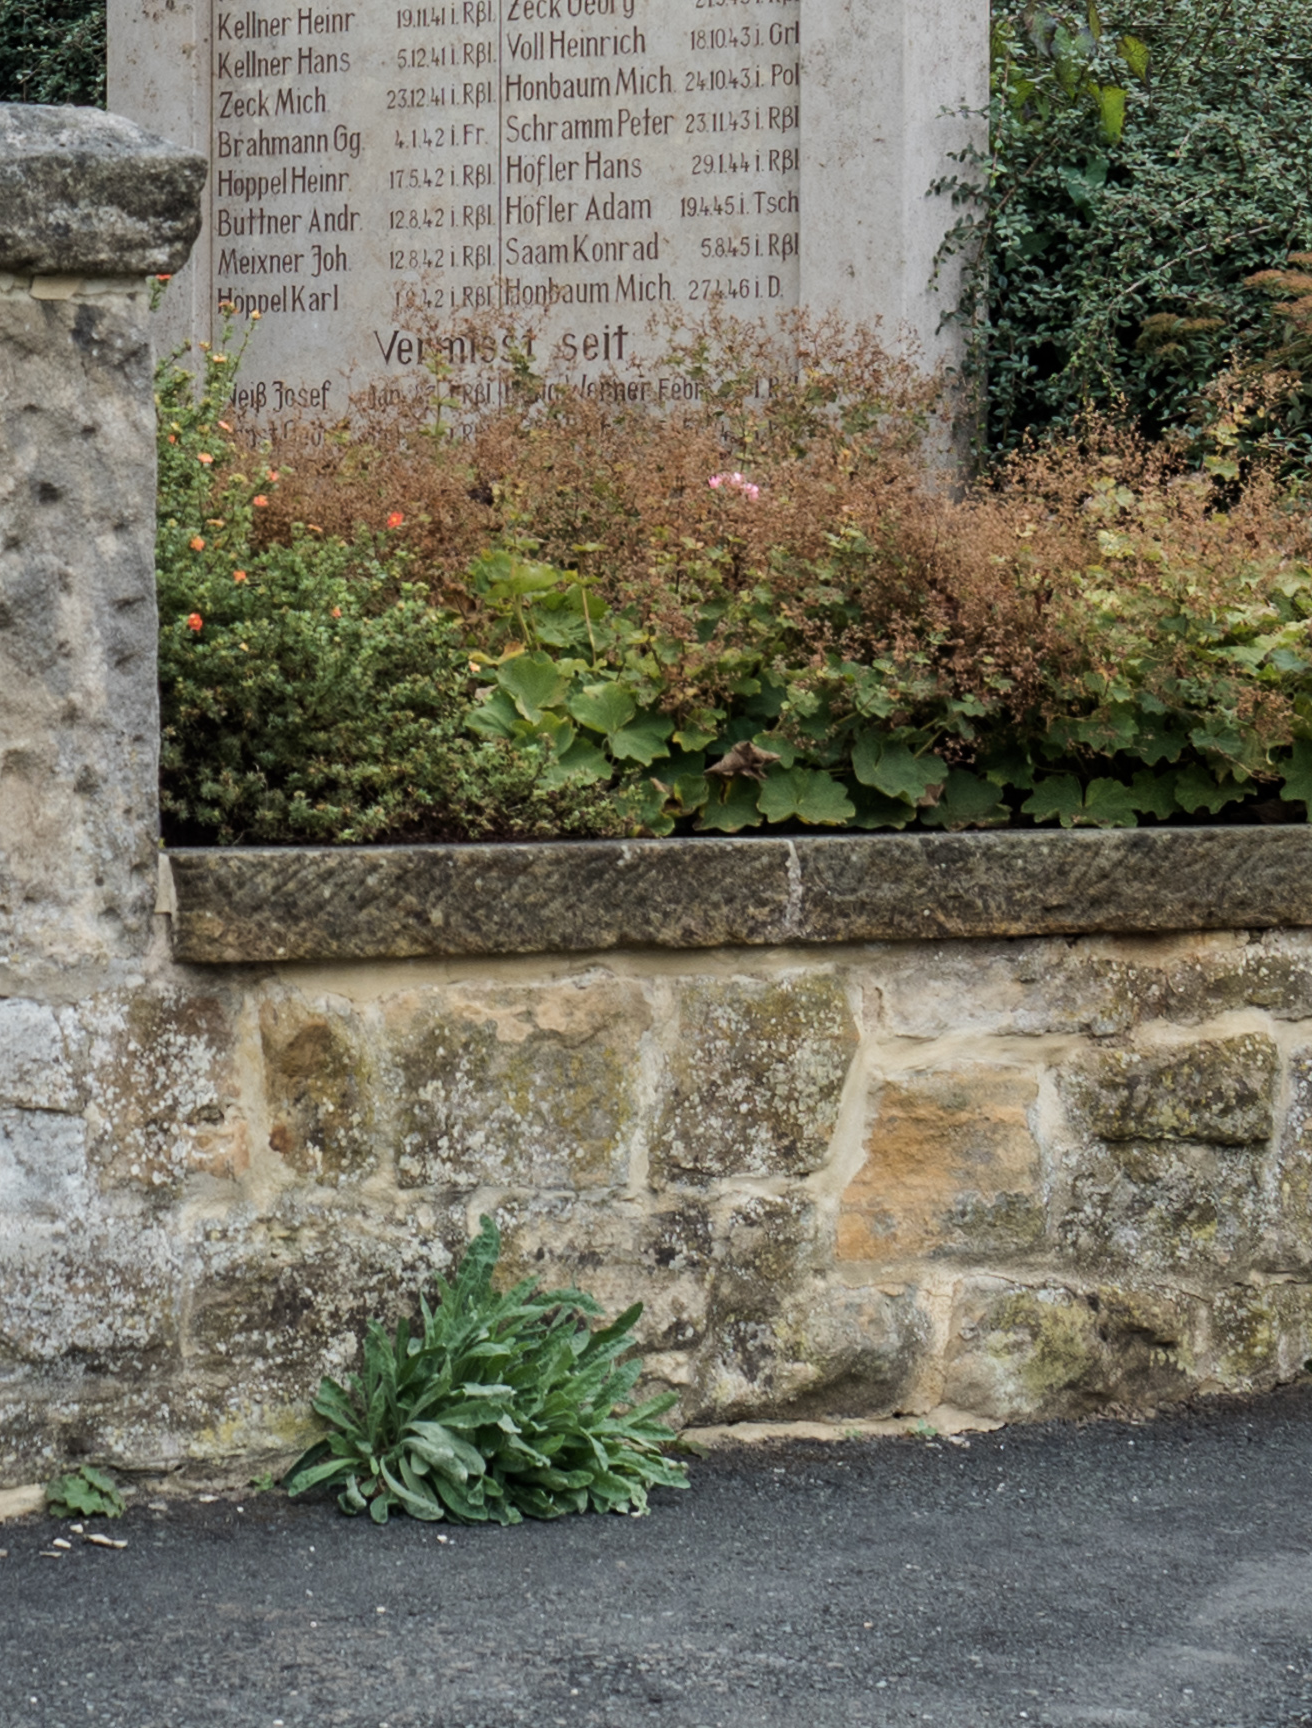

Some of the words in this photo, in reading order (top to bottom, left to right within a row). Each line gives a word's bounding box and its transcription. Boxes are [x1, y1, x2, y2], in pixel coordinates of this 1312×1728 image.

[218, 11, 292, 40] Kellner
[507, 32, 544, 61] Voll
[550, 25, 646, 59] Heinrich
[218, 51, 292, 79] Kellner
[298, 47, 350, 75] Hans
[505, 72, 610, 102] Honbaum
[615, 65, 676, 96] Mich.
[219, 90, 269, 119] Zeck
[275, 86, 330, 116] Mich.
[218, 129, 328, 158] Brahmann
[334, 124, 365, 159] Gg.
[506, 114, 613, 143] Schramm
[618, 108, 675, 137] Peter
[585, 151, 642, 180] Hans
[308, 204, 362, 233] Andr.
[585, 192, 651, 221] Adam
[218, 248, 304, 278] Meixner
[311, 244, 352, 277] Joh.
[506, 238, 568, 265] Saam
[573, 232, 658, 263] Konrad
[291, 284, 338, 312] Karl
[615, 273, 675, 301] Mich.
[768, 275, 784, 298] D.
[562, 324, 629, 362] seit
